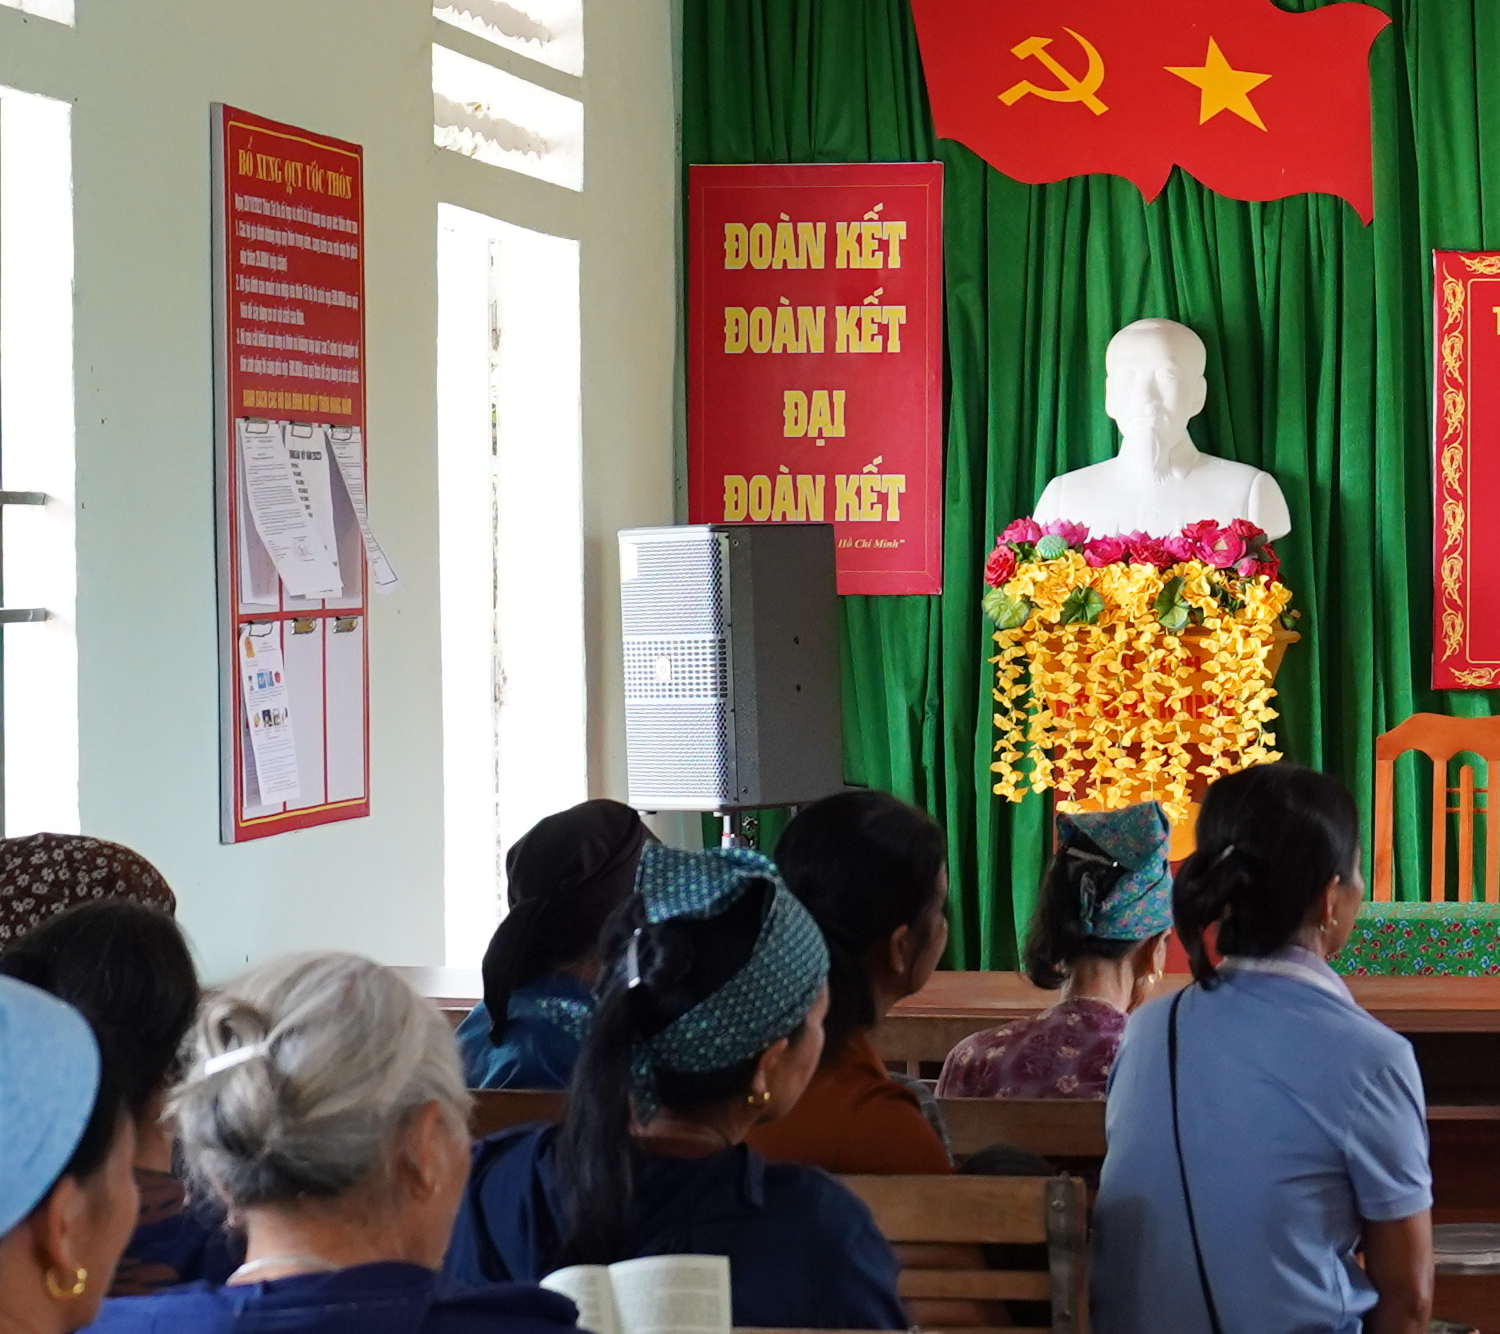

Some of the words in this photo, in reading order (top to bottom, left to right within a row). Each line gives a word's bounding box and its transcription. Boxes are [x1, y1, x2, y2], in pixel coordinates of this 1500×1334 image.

[724, 212, 826, 269] ĐOÀN
[835, 202, 906, 269] KẾT
[724, 296, 826, 353] ĐOÀN
[835, 287, 906, 353] KẾT
[783, 390, 846, 446] ĐẠI
[723, 465, 825, 522] ĐOÀN
[834, 455, 905, 522] KẾT
